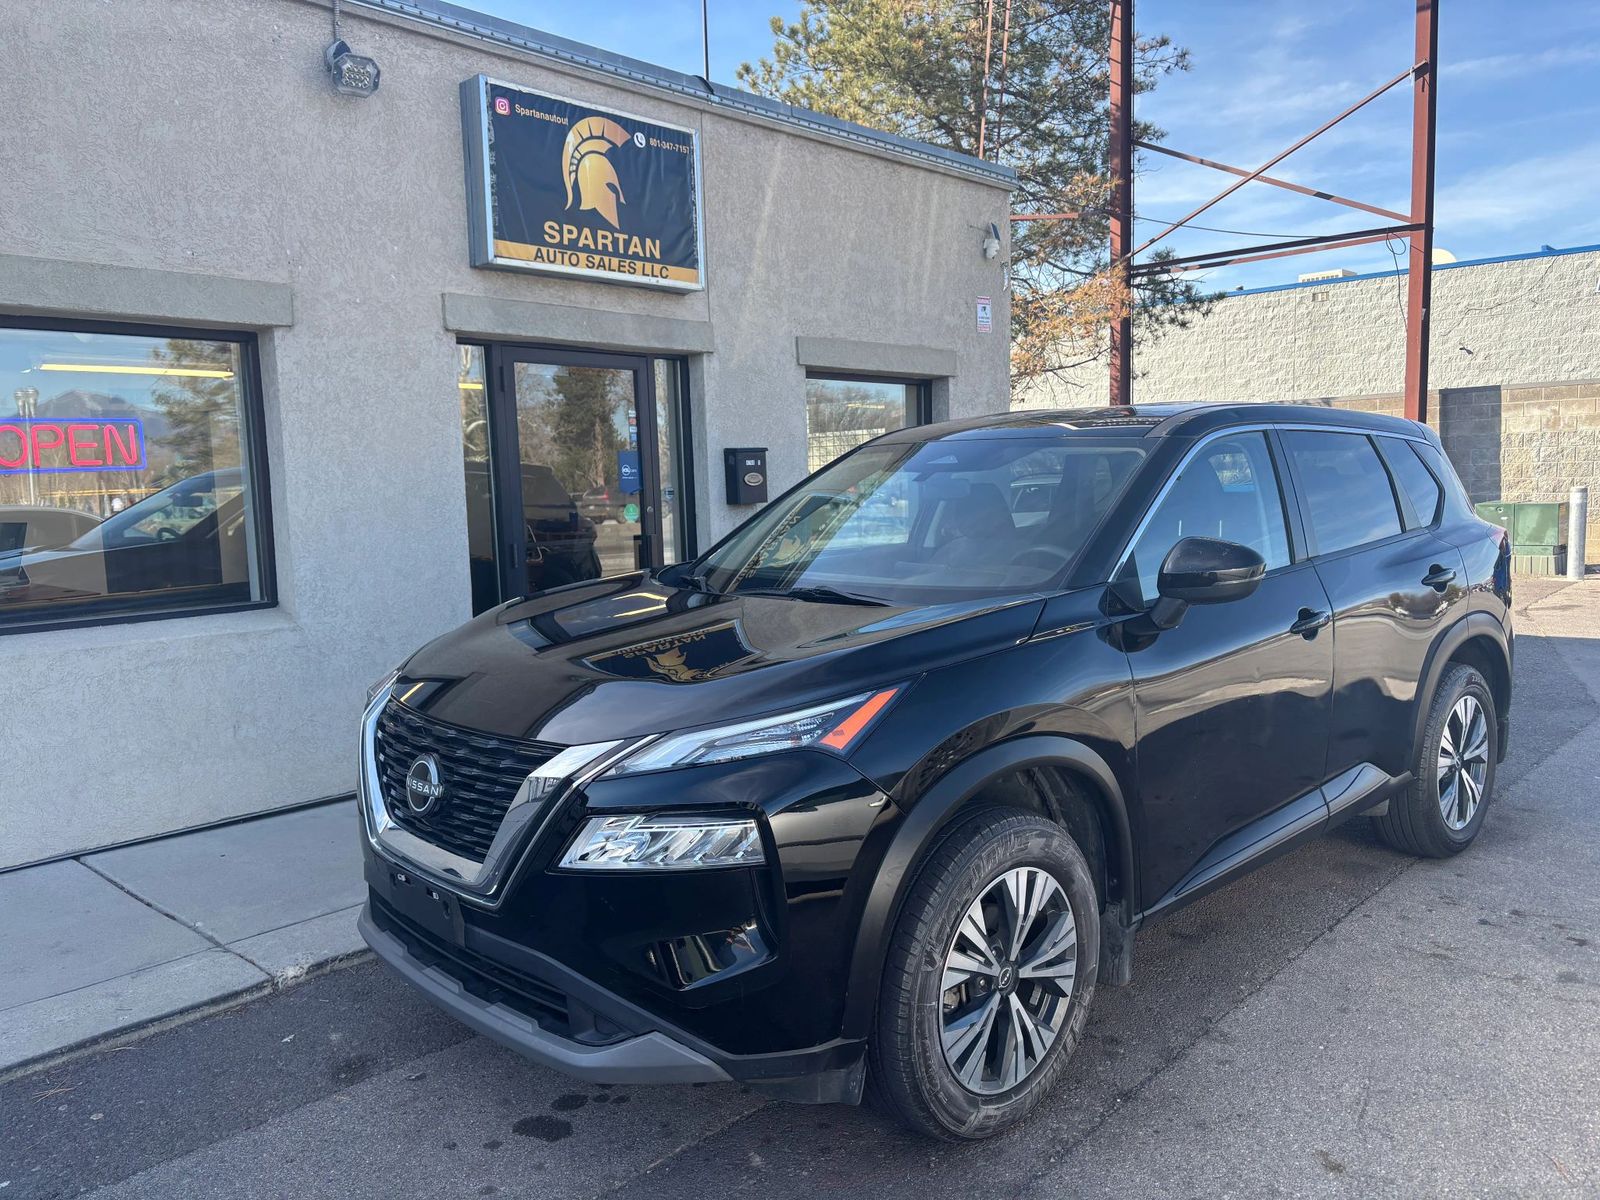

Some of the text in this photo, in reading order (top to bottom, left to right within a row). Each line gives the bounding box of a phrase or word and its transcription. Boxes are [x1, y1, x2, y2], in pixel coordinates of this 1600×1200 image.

[543, 220, 661, 260] SPARTAN
[533, 247, 669, 279] AUTO SALES LLC
[0, 424, 138, 468] OPEN
